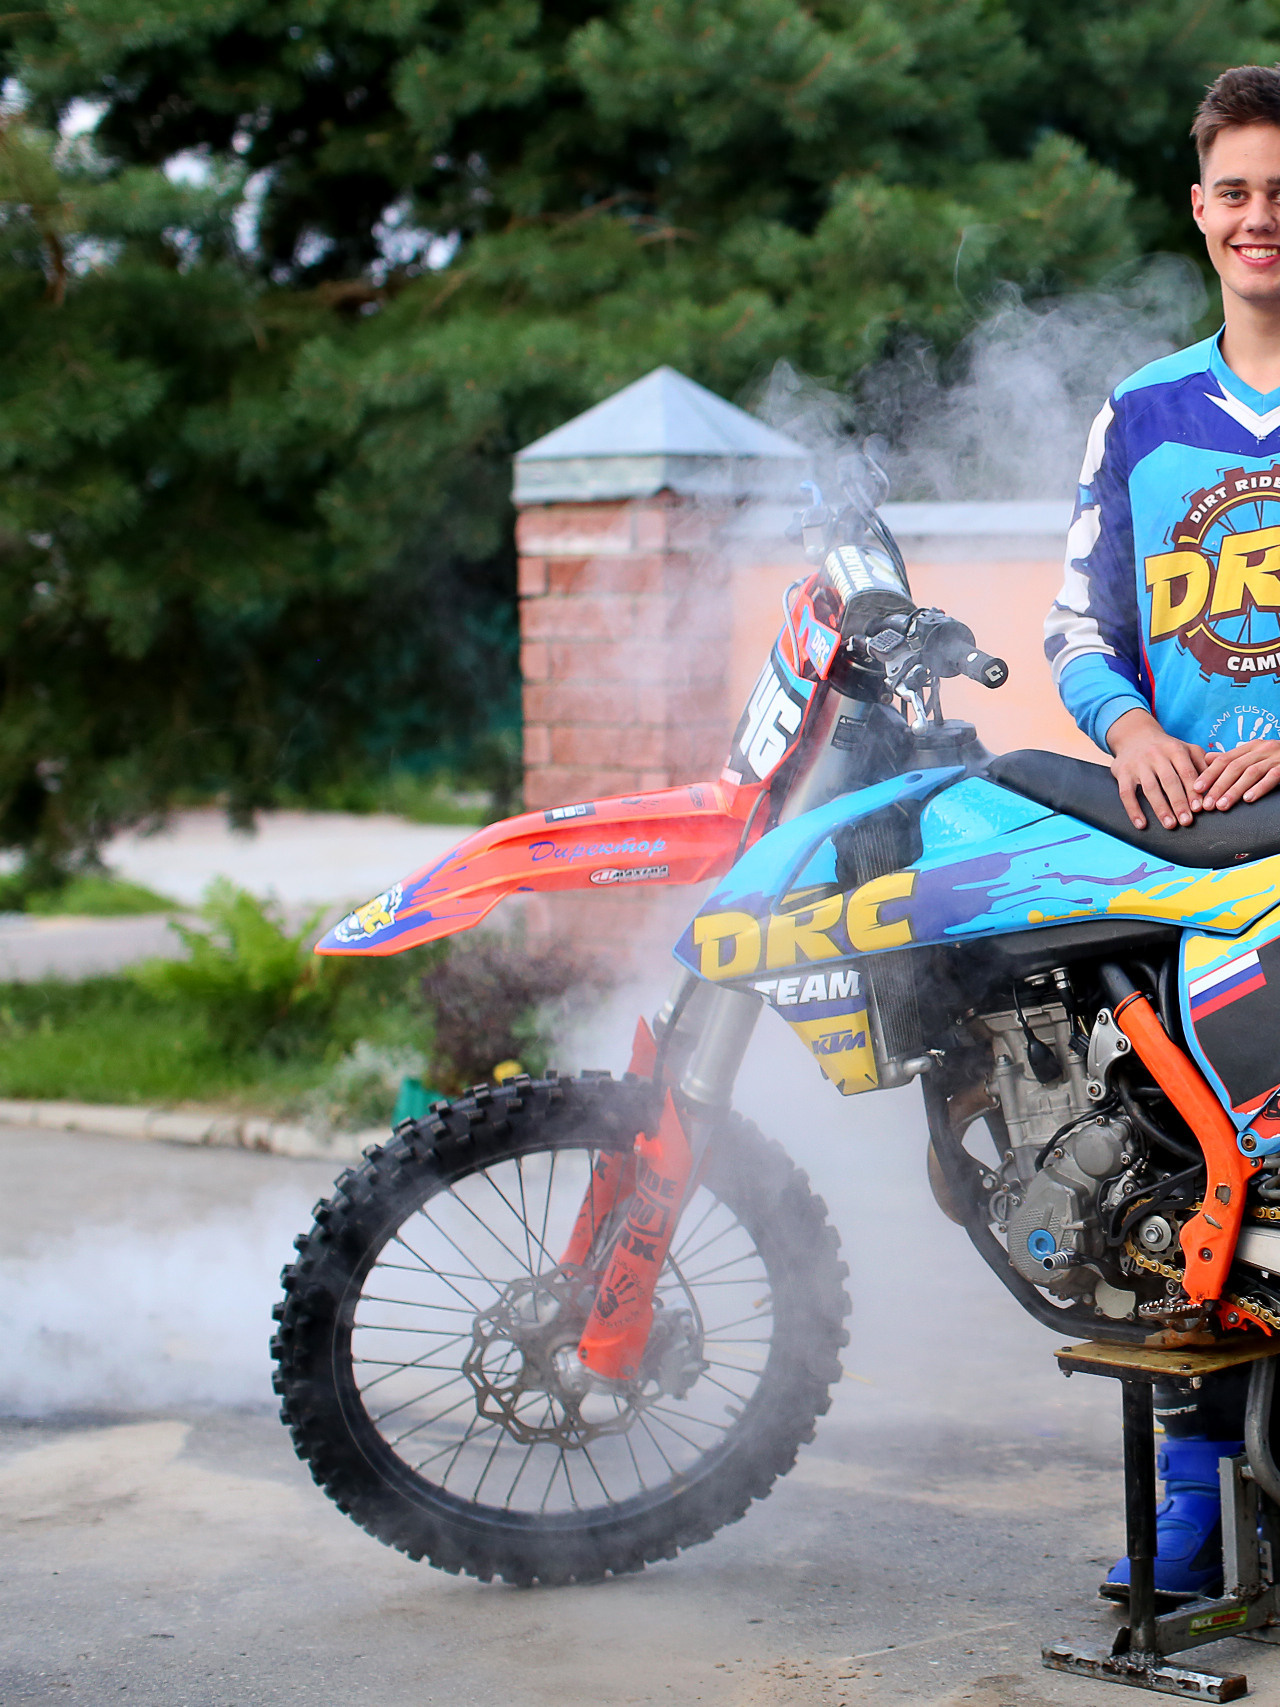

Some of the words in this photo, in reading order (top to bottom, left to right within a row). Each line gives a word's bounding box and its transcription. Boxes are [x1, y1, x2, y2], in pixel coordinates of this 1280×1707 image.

[1189, 486, 1227, 525] DIRT
[1208, 711, 1231, 738] YAMI
[528, 836, 667, 864] Директор
[694, 870, 920, 981] DRC
[753, 970, 862, 1006] TEAM
[812, 1028, 866, 1055] KTM
